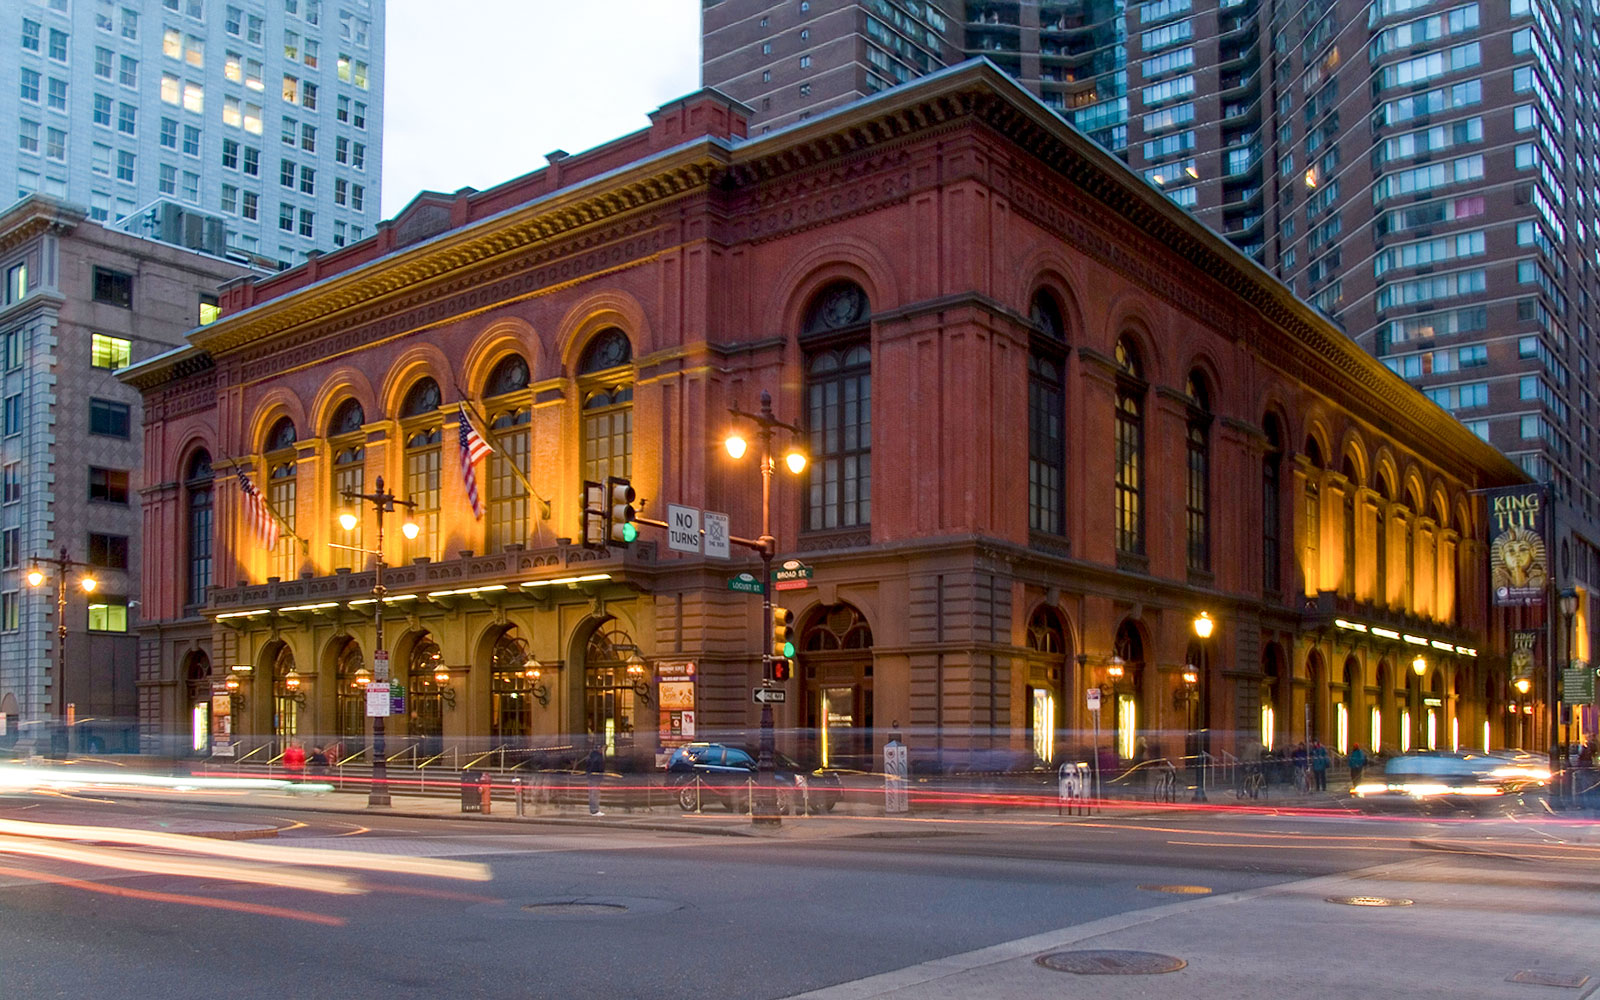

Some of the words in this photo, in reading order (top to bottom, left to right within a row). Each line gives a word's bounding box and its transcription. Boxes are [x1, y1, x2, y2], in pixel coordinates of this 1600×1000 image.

[1494, 493, 1539, 511] KING
[676, 512, 693, 528] NO
[1494, 509, 1539, 529] TUT
[670, 530, 698, 546] TURNS
[777, 570, 797, 580] BROAD
[732, 581, 752, 591] LOCUST
[1514, 632, 1535, 641] KING
